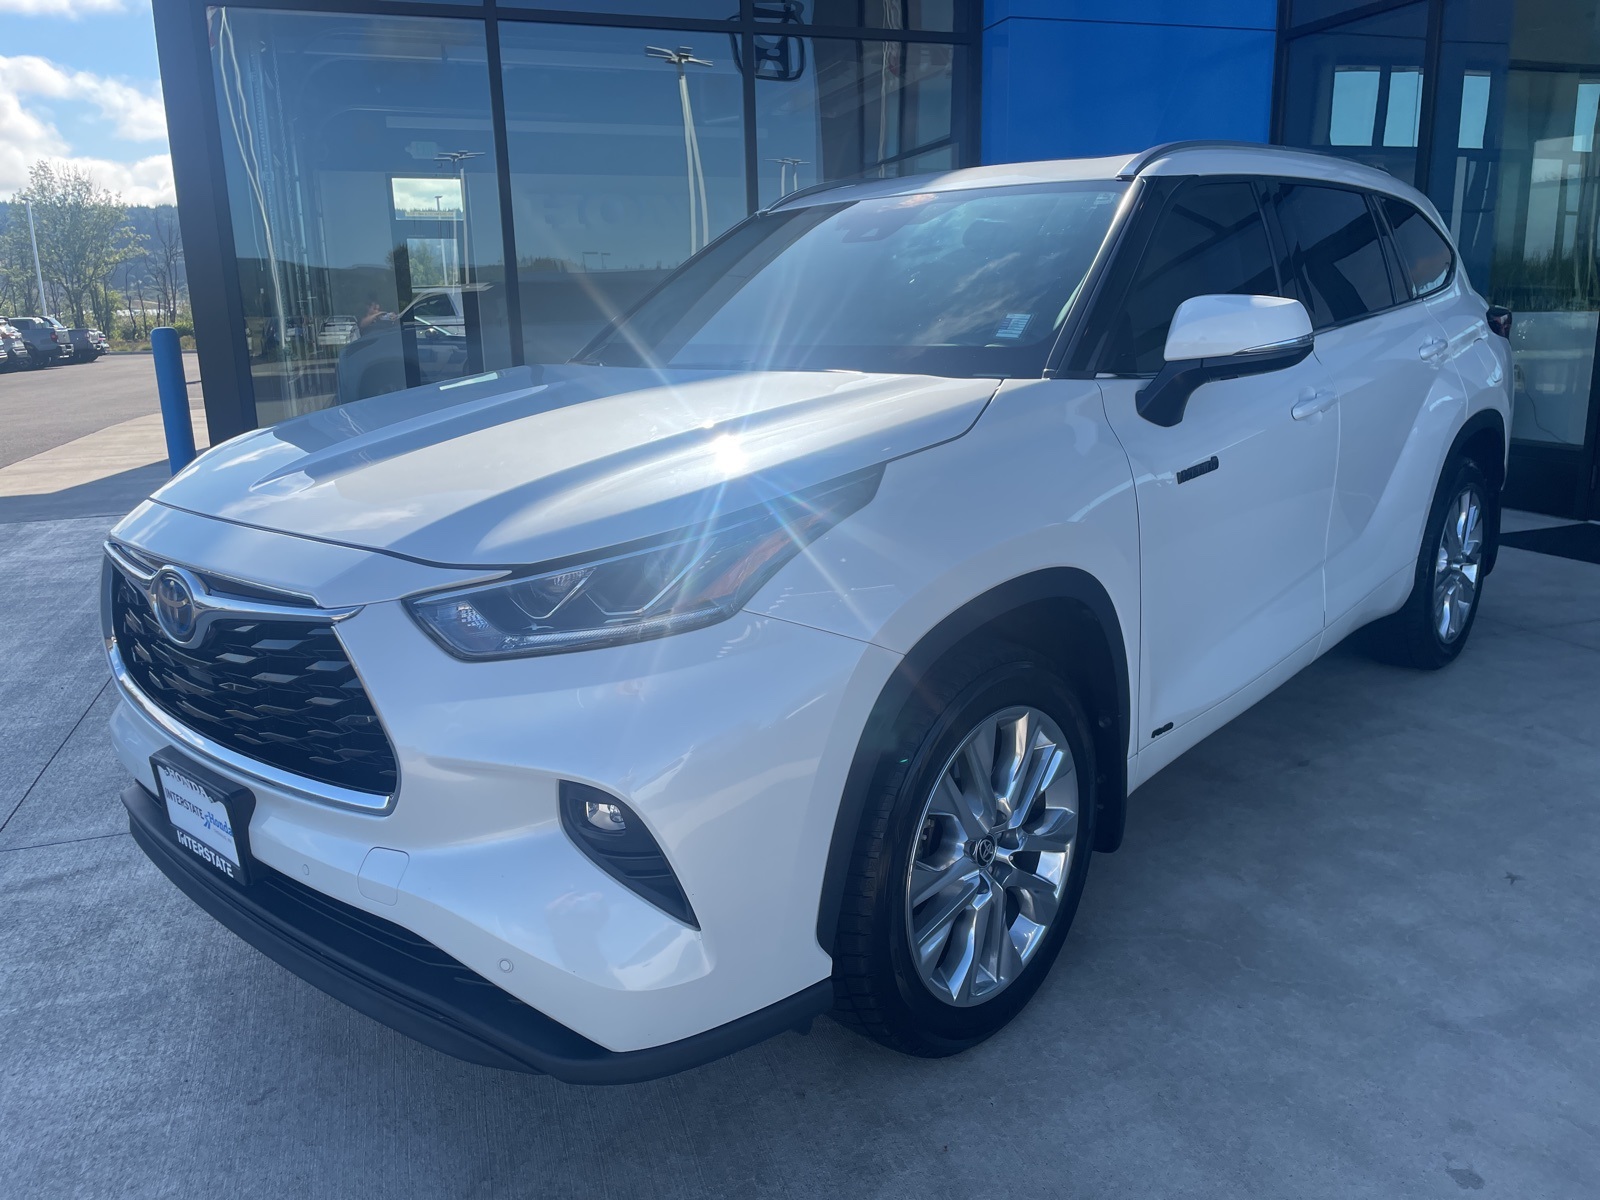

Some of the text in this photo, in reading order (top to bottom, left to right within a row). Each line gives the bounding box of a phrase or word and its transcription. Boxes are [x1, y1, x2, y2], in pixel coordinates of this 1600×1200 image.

[164, 787, 205, 820] INTERSTATE
[206, 811, 233, 836] Honda
[176, 829, 234, 878] INTERSTATE
